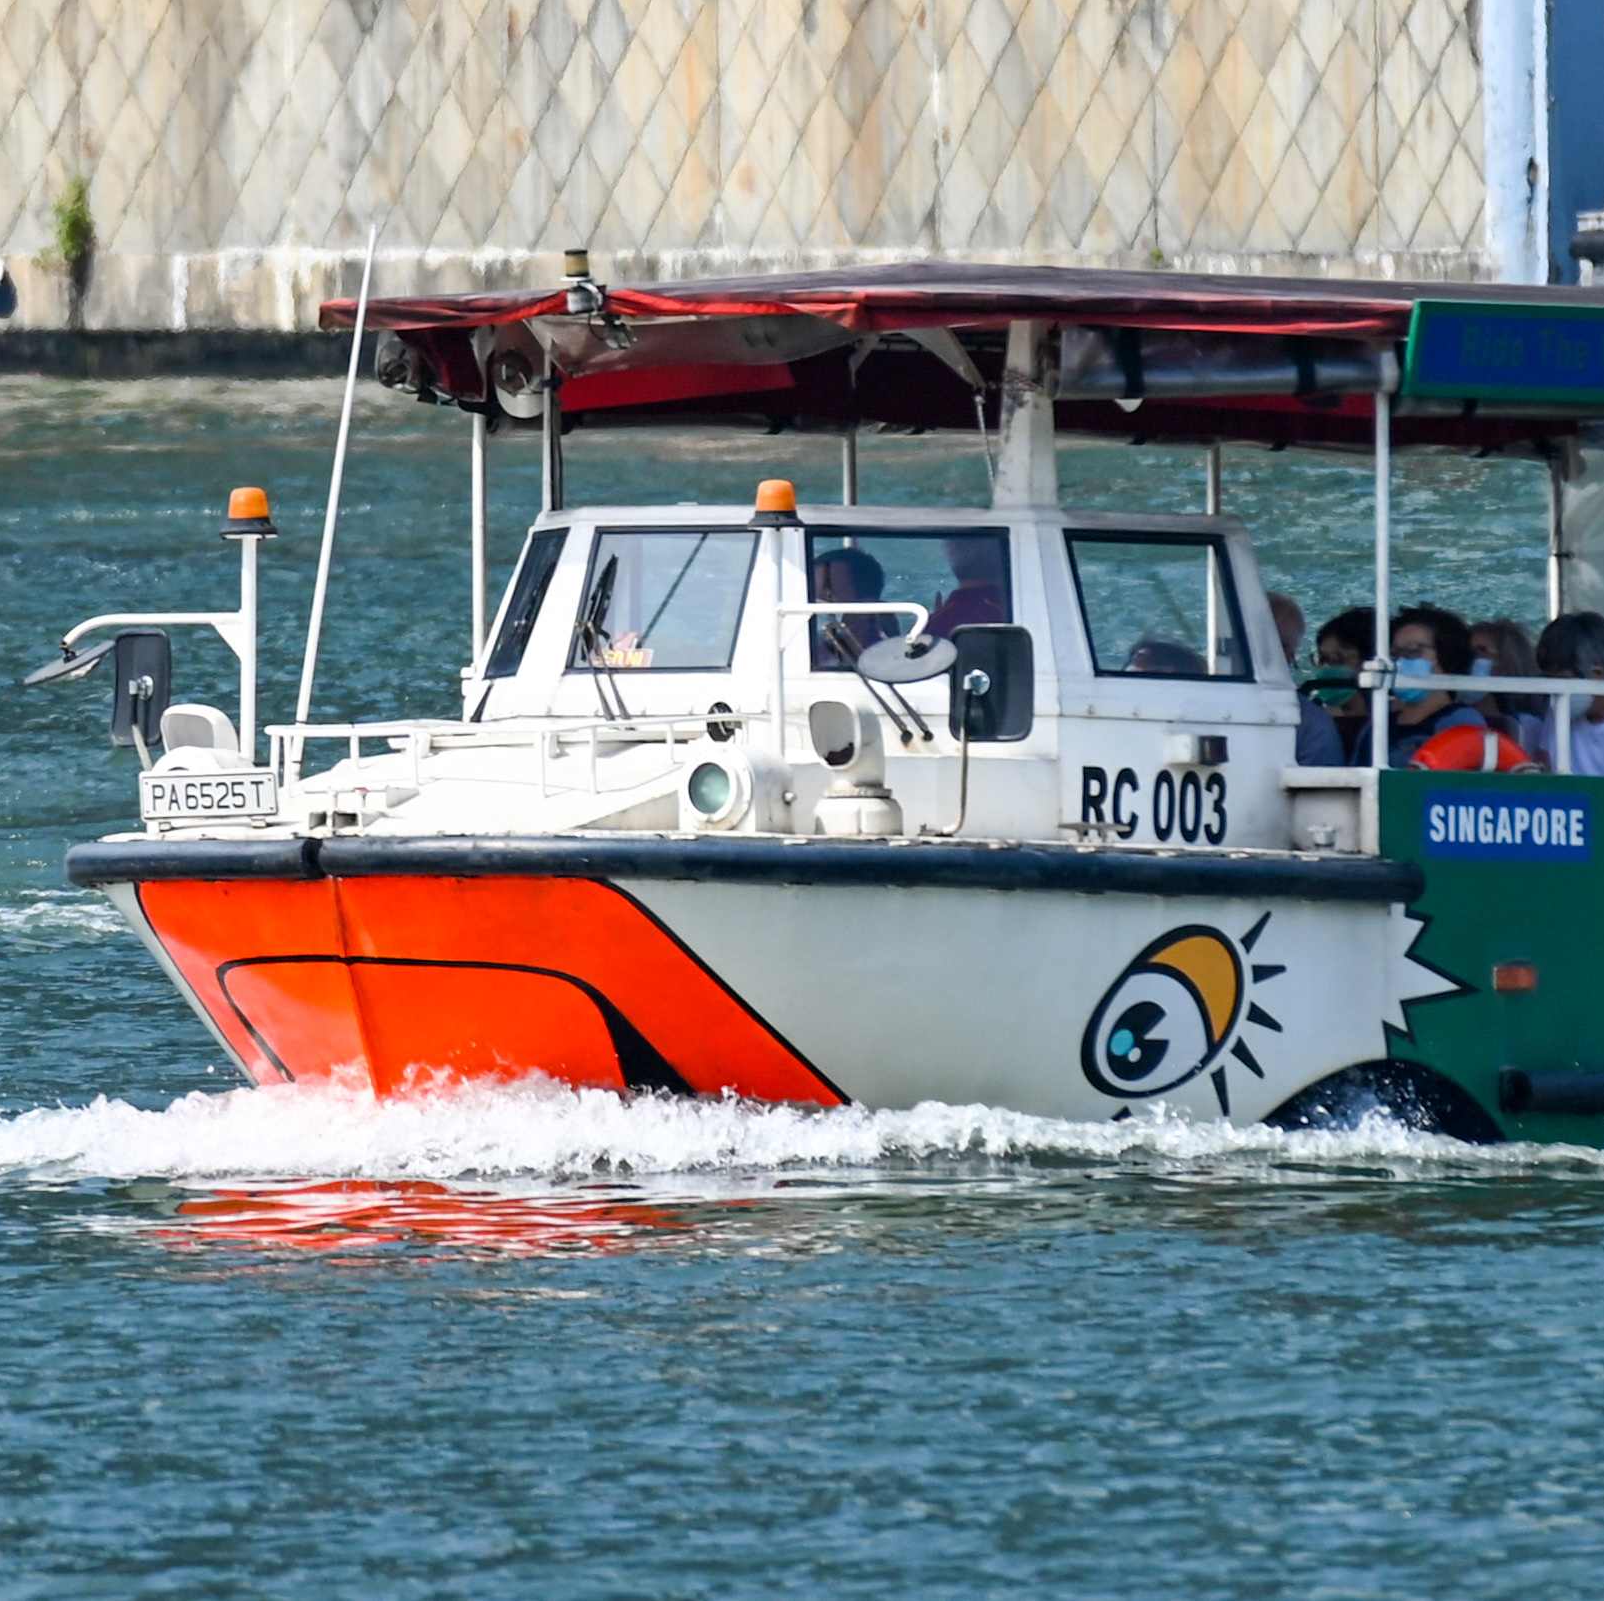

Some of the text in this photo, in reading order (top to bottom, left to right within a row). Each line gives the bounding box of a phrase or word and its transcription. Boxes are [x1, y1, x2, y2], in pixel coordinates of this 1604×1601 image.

[152, 780, 264, 811] PA6525T
[1081, 765, 1228, 845] RC 003
[1429, 804, 1584, 847] SINGAPORE
